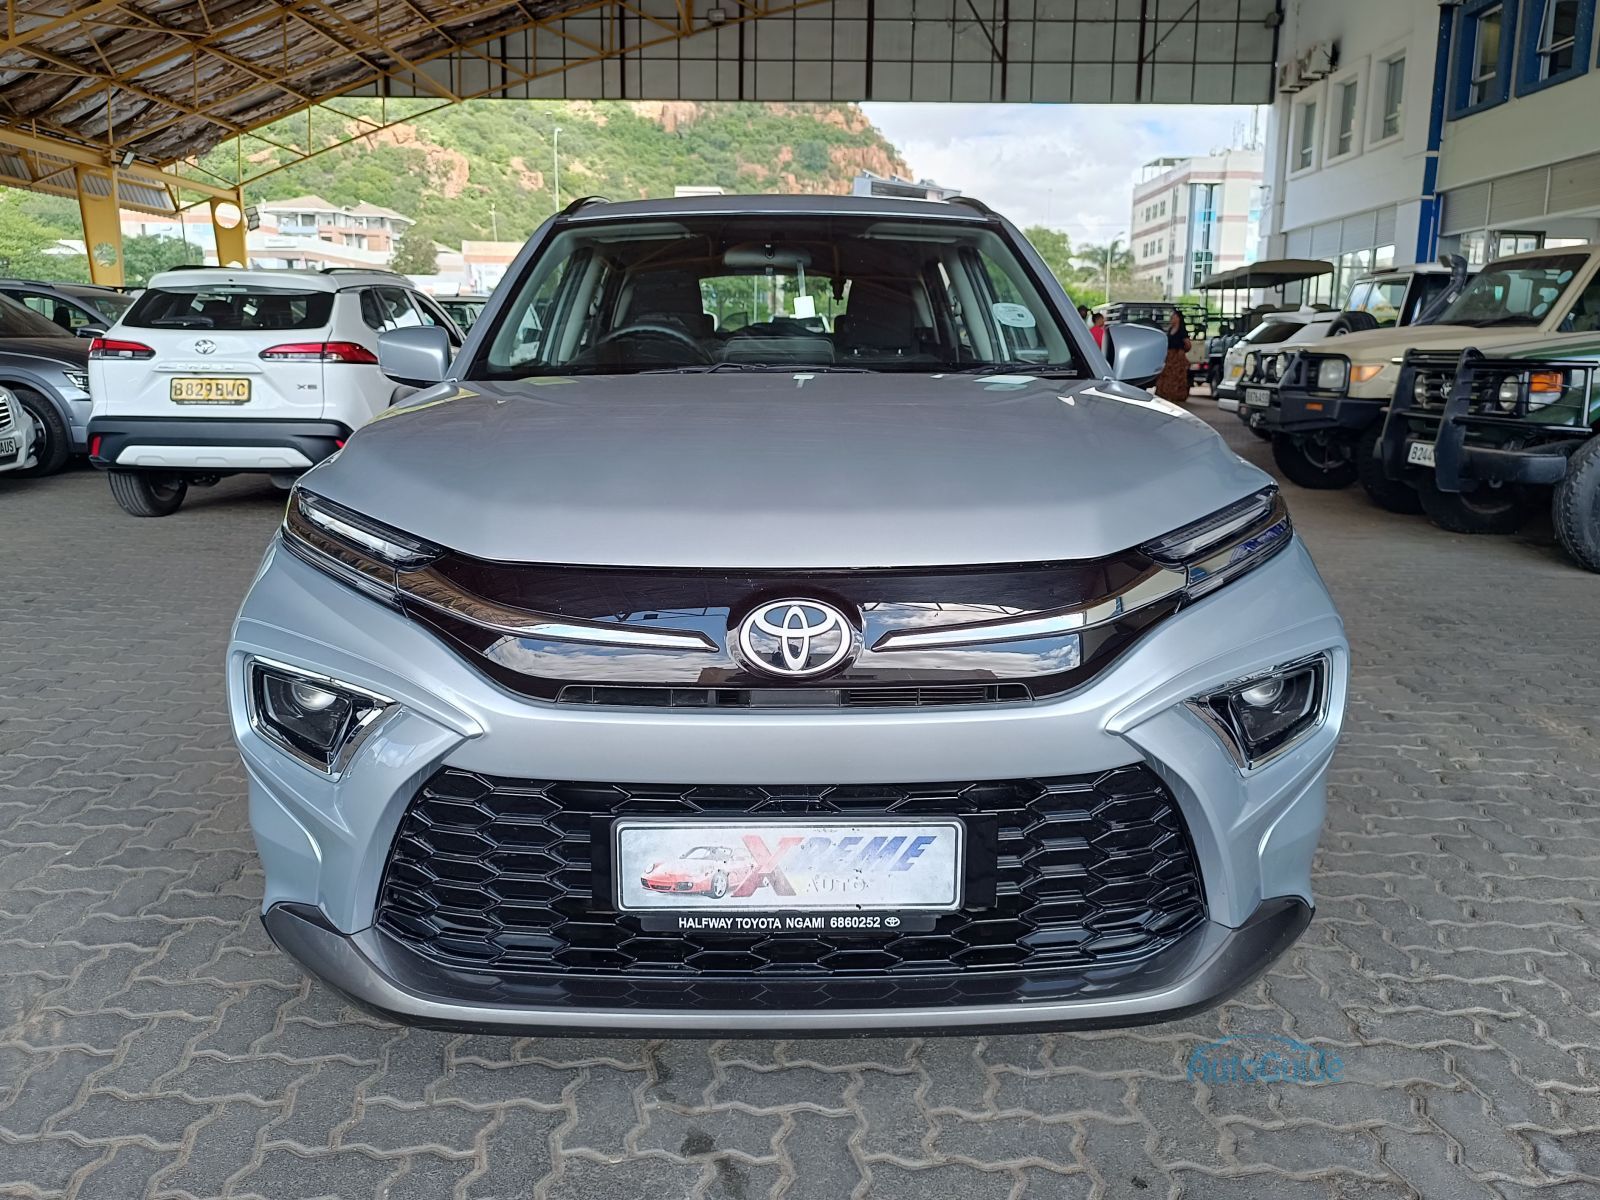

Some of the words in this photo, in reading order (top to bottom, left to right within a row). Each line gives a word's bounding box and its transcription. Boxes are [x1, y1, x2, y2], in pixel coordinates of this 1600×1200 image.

[678, 917, 733, 929] HALFWAY
[735, 917, 782, 929] TOYOTA
[786, 917, 825, 929] NGAMI
[829, 916, 881, 928] 6860252
